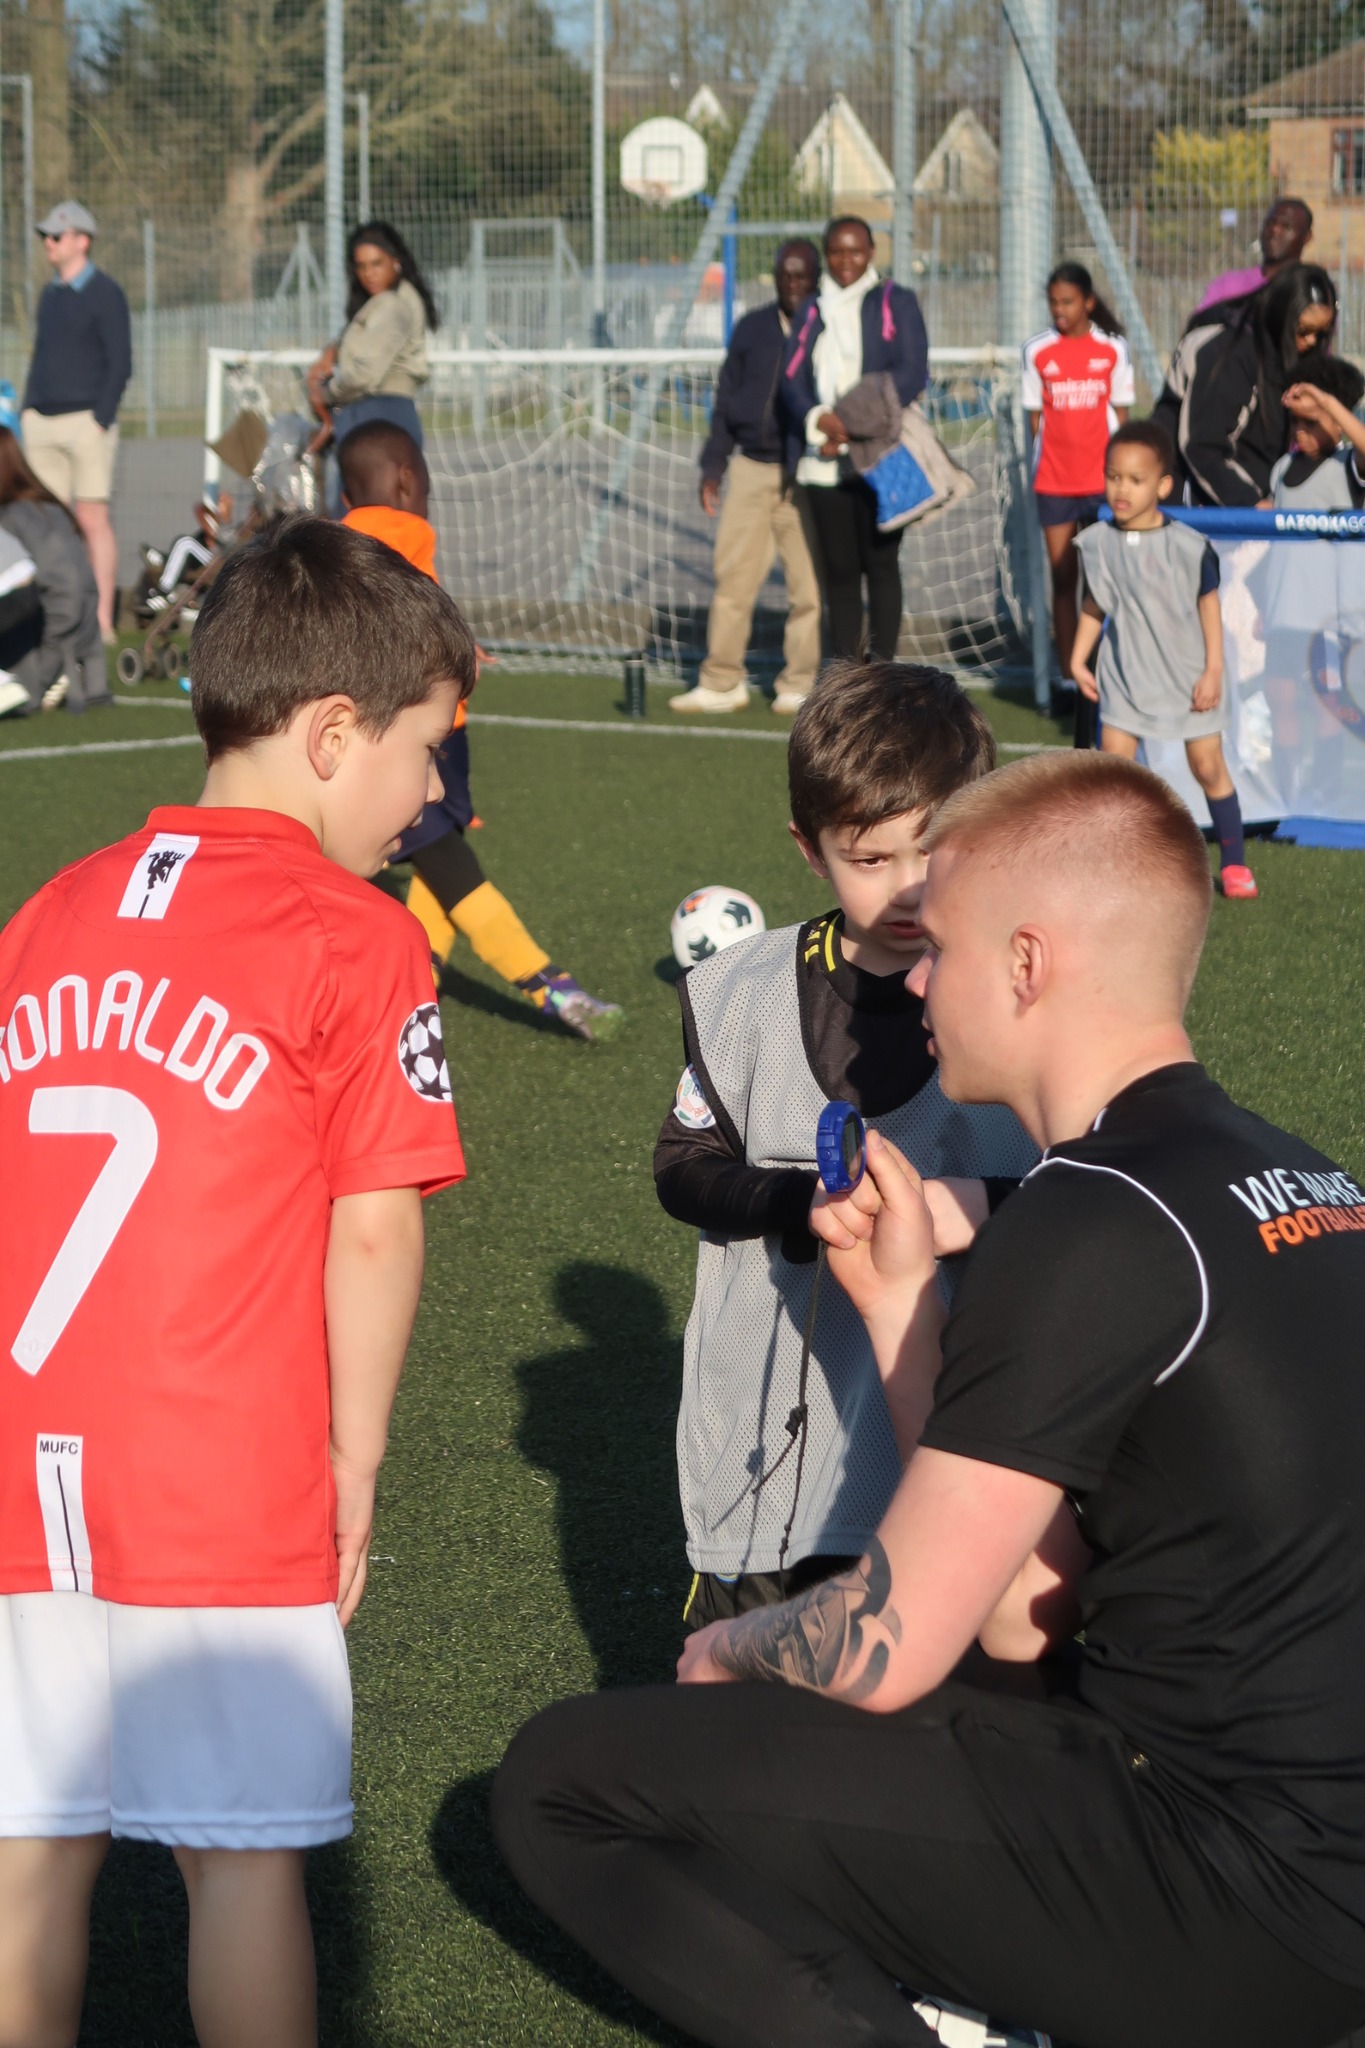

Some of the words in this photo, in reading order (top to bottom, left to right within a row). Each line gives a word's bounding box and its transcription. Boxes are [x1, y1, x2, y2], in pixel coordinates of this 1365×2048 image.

[1228, 1168, 1312, 1221] WE
[1292, 1170, 1365, 1206] MAKE
[10, 1085, 158, 1376] 7
[39, 1440, 79, 1455] MUFC
